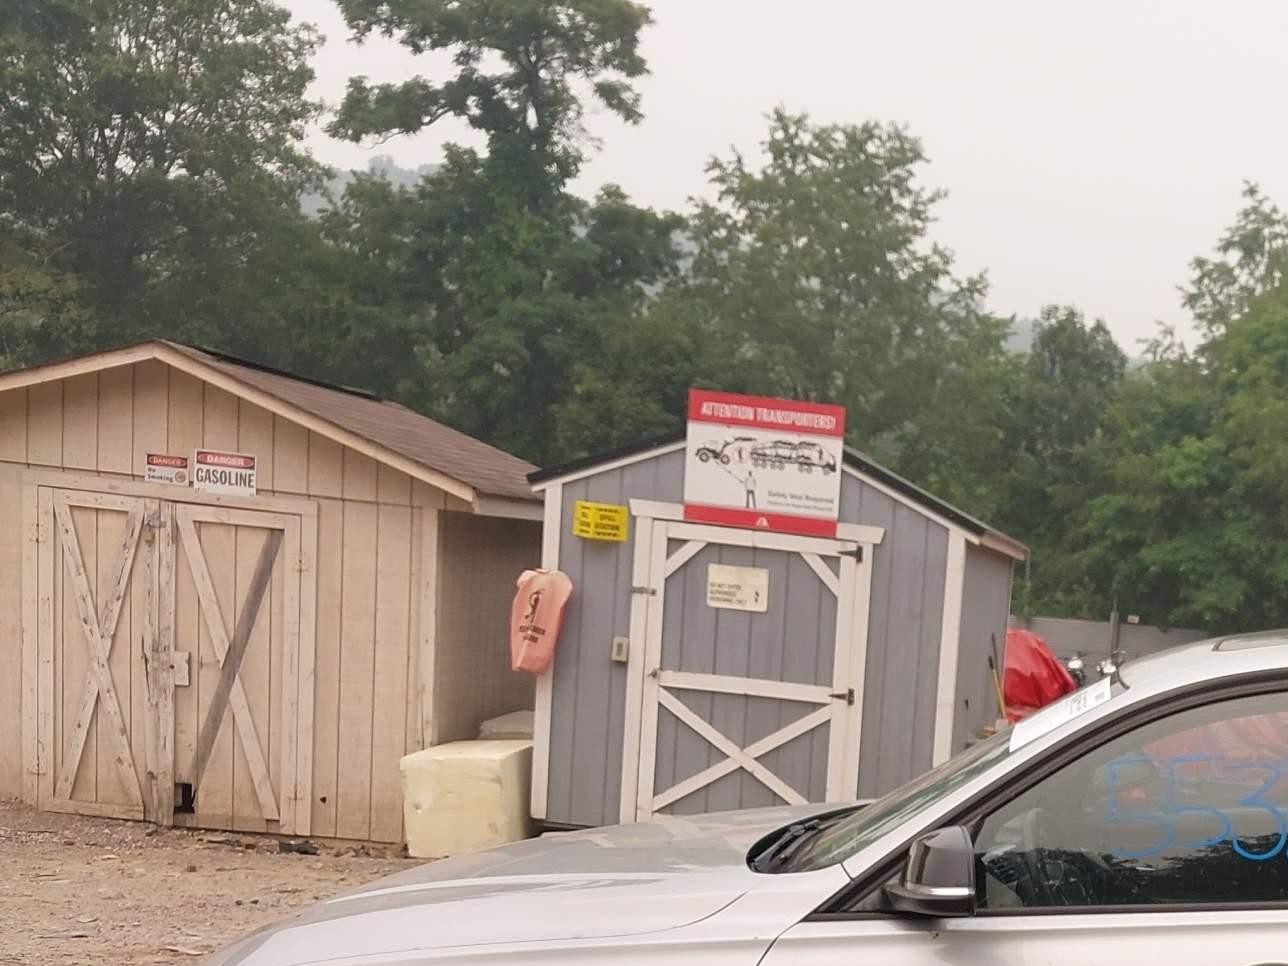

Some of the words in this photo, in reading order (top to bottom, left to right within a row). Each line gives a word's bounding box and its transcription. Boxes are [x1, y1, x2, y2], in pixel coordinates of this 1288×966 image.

[701, 402, 754, 420] ATTENTION
[756, 407, 837, 430] TRANSPORTERS!
[207, 455, 245, 466] DANGER
[196, 467, 255, 488] GASOLINE
